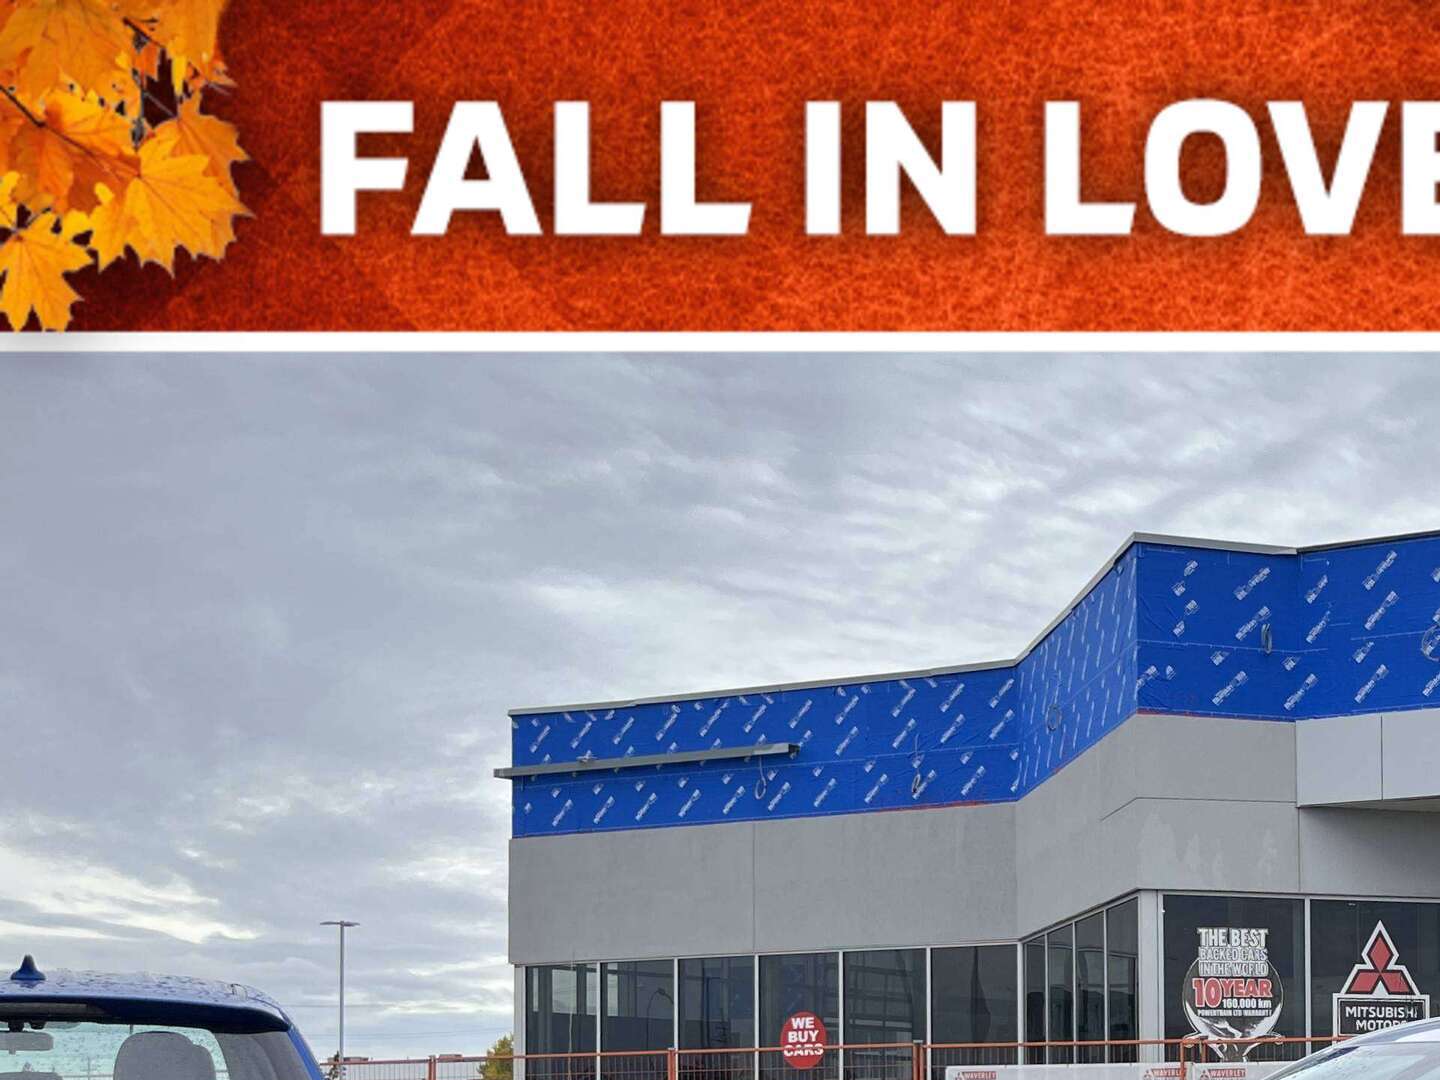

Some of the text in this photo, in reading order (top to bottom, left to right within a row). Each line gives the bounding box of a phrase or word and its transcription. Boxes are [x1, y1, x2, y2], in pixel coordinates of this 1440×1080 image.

[1199, 928, 1268, 947] THE BEST
[1192, 977, 1272, 1008] 10 YEAR
[1258, 999, 1272, 1008] km
[1345, 1006, 1418, 1019] MITSUBISHI
[791, 1017, 815, 1029] WE
[788, 1030, 819, 1043] BUY
[783, 1043, 824, 1057] CARS
